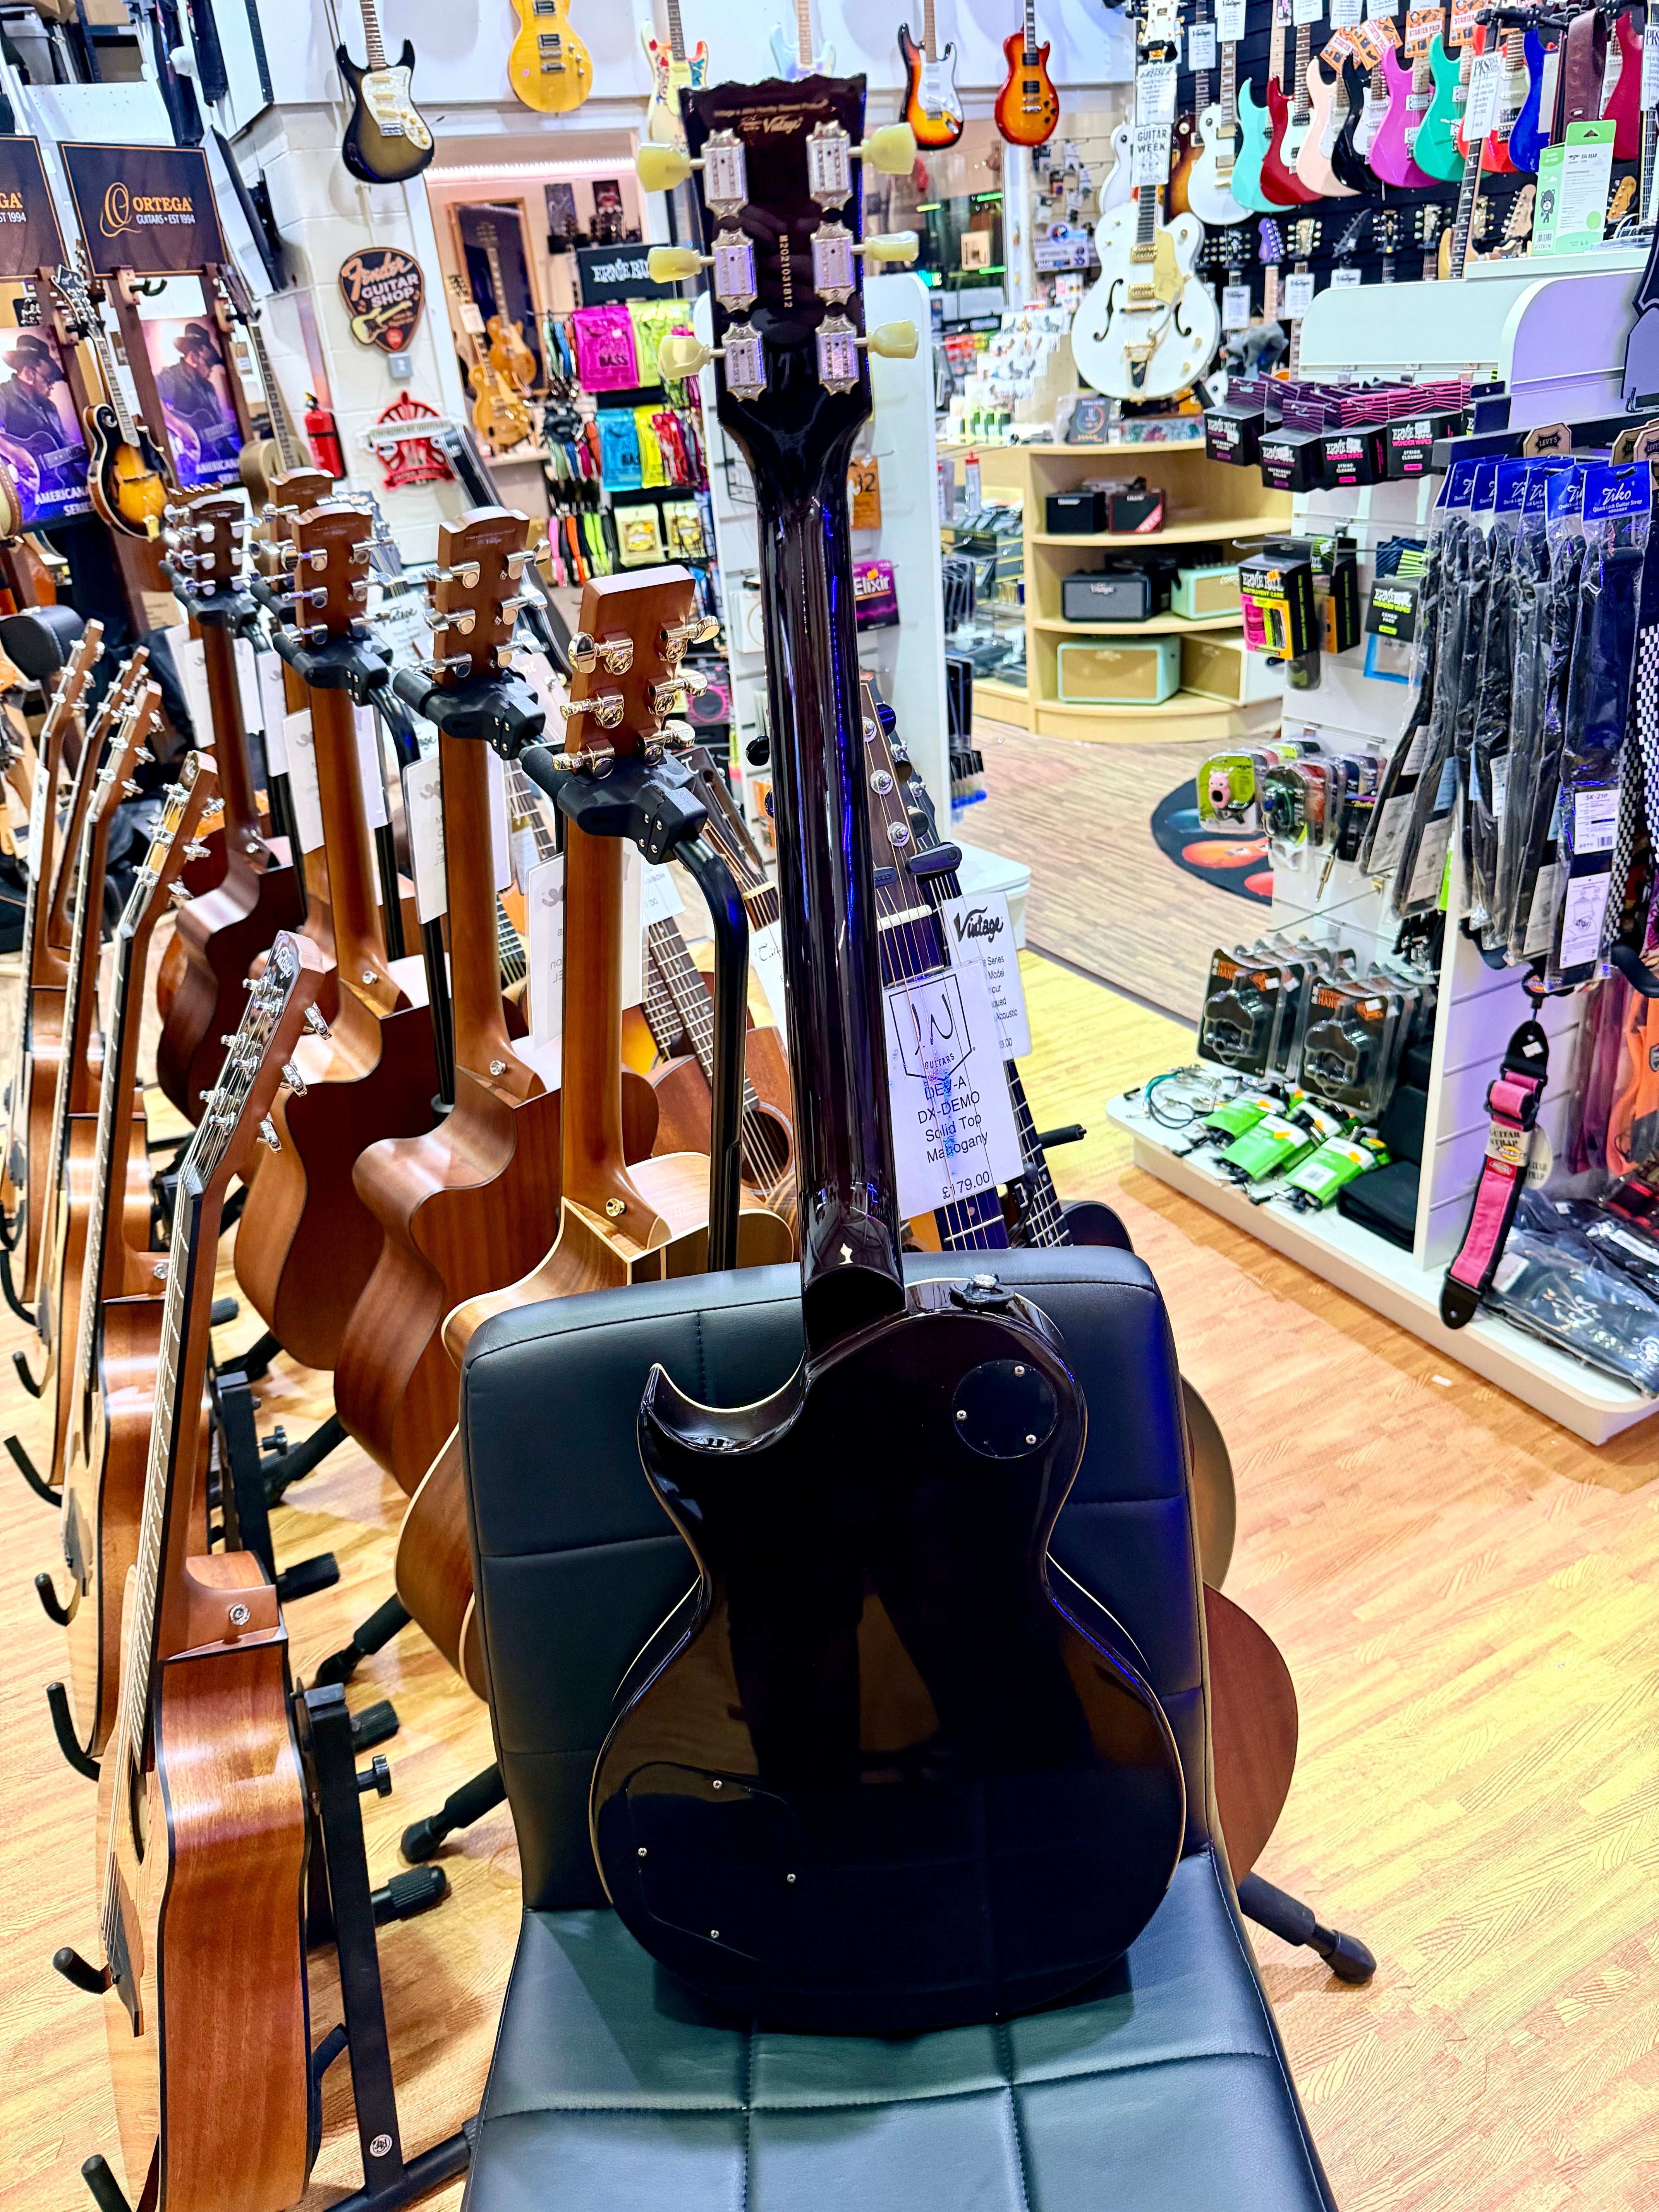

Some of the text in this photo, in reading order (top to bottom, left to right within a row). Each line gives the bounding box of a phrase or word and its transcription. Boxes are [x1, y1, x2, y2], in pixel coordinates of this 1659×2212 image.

[1454, 14, 1475, 25] STARTER
[1409, 24, 1441, 37] STARTER PACK
[1137, 129, 1167, 141] GUITAR
[1137, 143, 1166, 153] WEEK
[132, 197, 193, 212] ORTEGA
[8, 213, 26, 223] 1994
[136, 214, 196, 224] GUITARS EST 1994
[341, 252, 413, 302] Fender
[361, 273, 419, 299] GUITAR
[371, 287, 414, 308] SHOP
[853, 574, 890, 596] Elixir
[953, 906, 1004, 943] Vintage
[987, 955, 1004, 965] Series
[988, 968, 1005, 979] Model
[924, 1053, 955, 1069] GUITARS
[917, 1091, 980, 1124] DX-DEMO
[926, 1114, 982, 1142] Solid Top
[942, 1171, 990, 1200] £179.00
